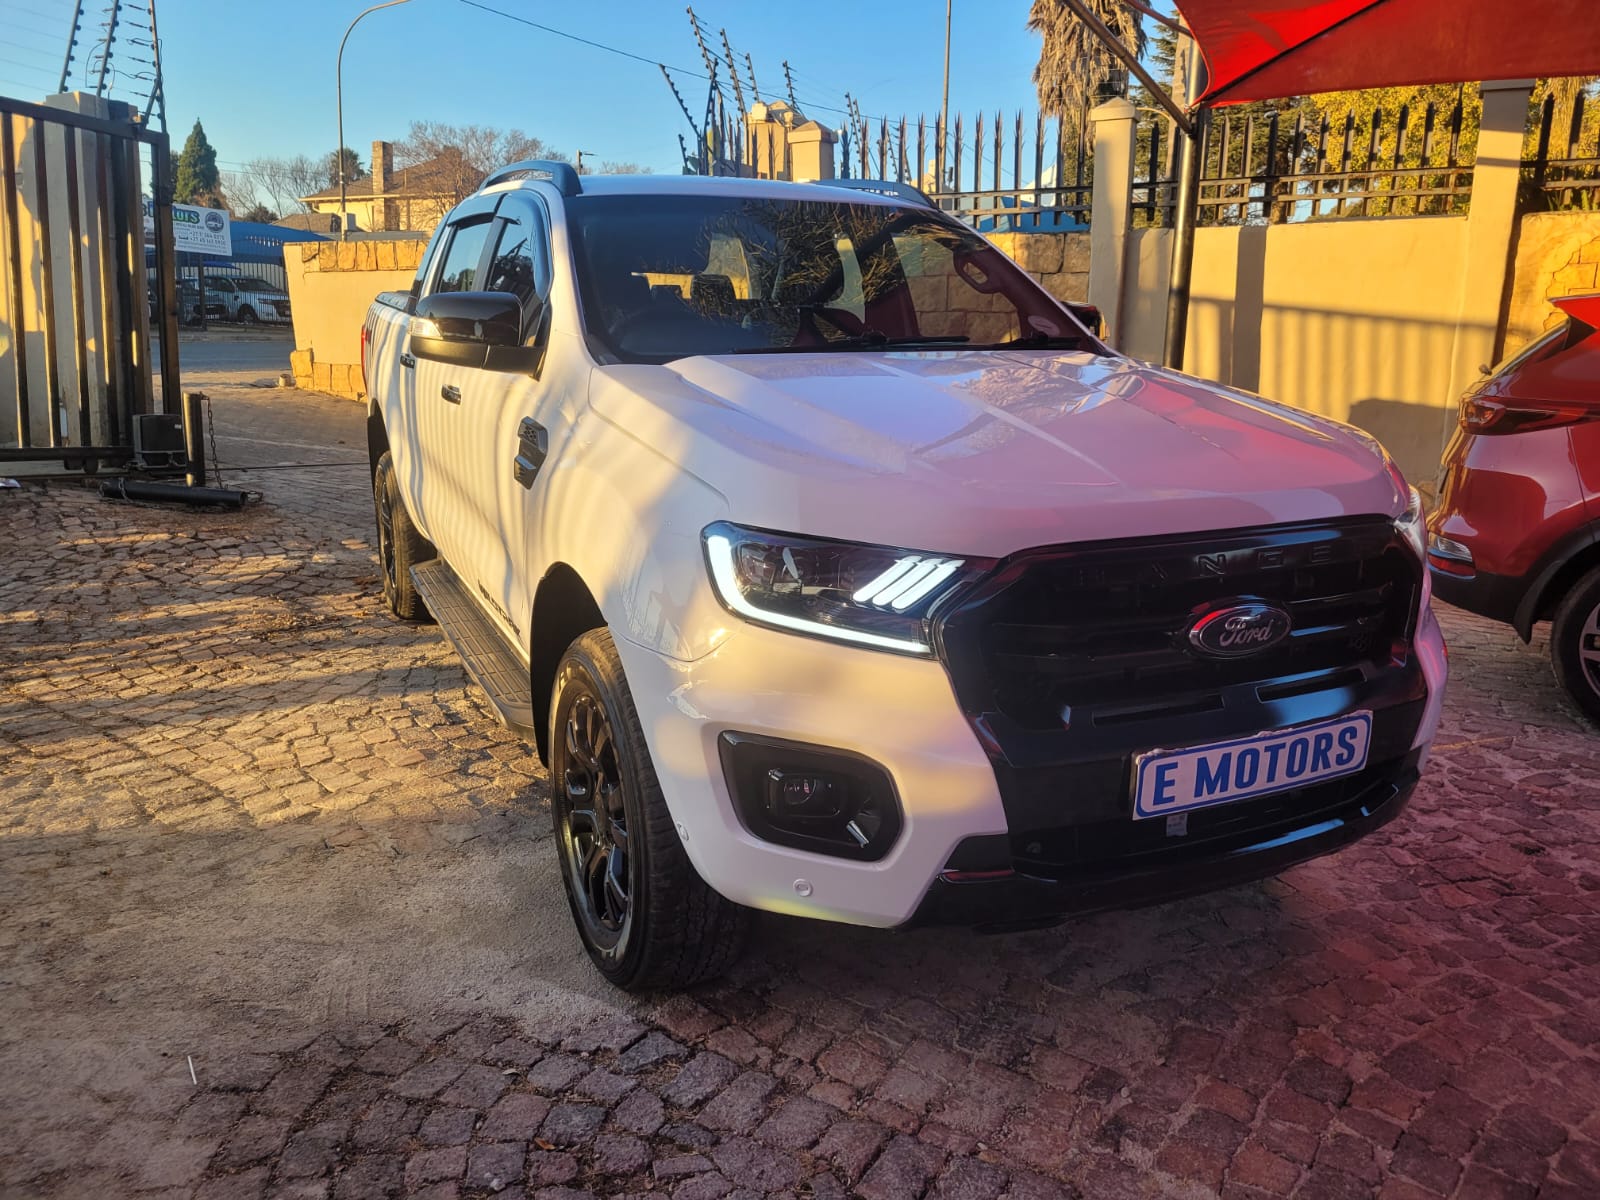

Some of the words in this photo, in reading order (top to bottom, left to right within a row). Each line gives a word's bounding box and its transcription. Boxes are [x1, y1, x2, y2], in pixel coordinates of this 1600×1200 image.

[1219, 615, 1273, 647] Ford
[1152, 762, 1179, 806] E
[1193, 726, 1358, 798] MOTORS
